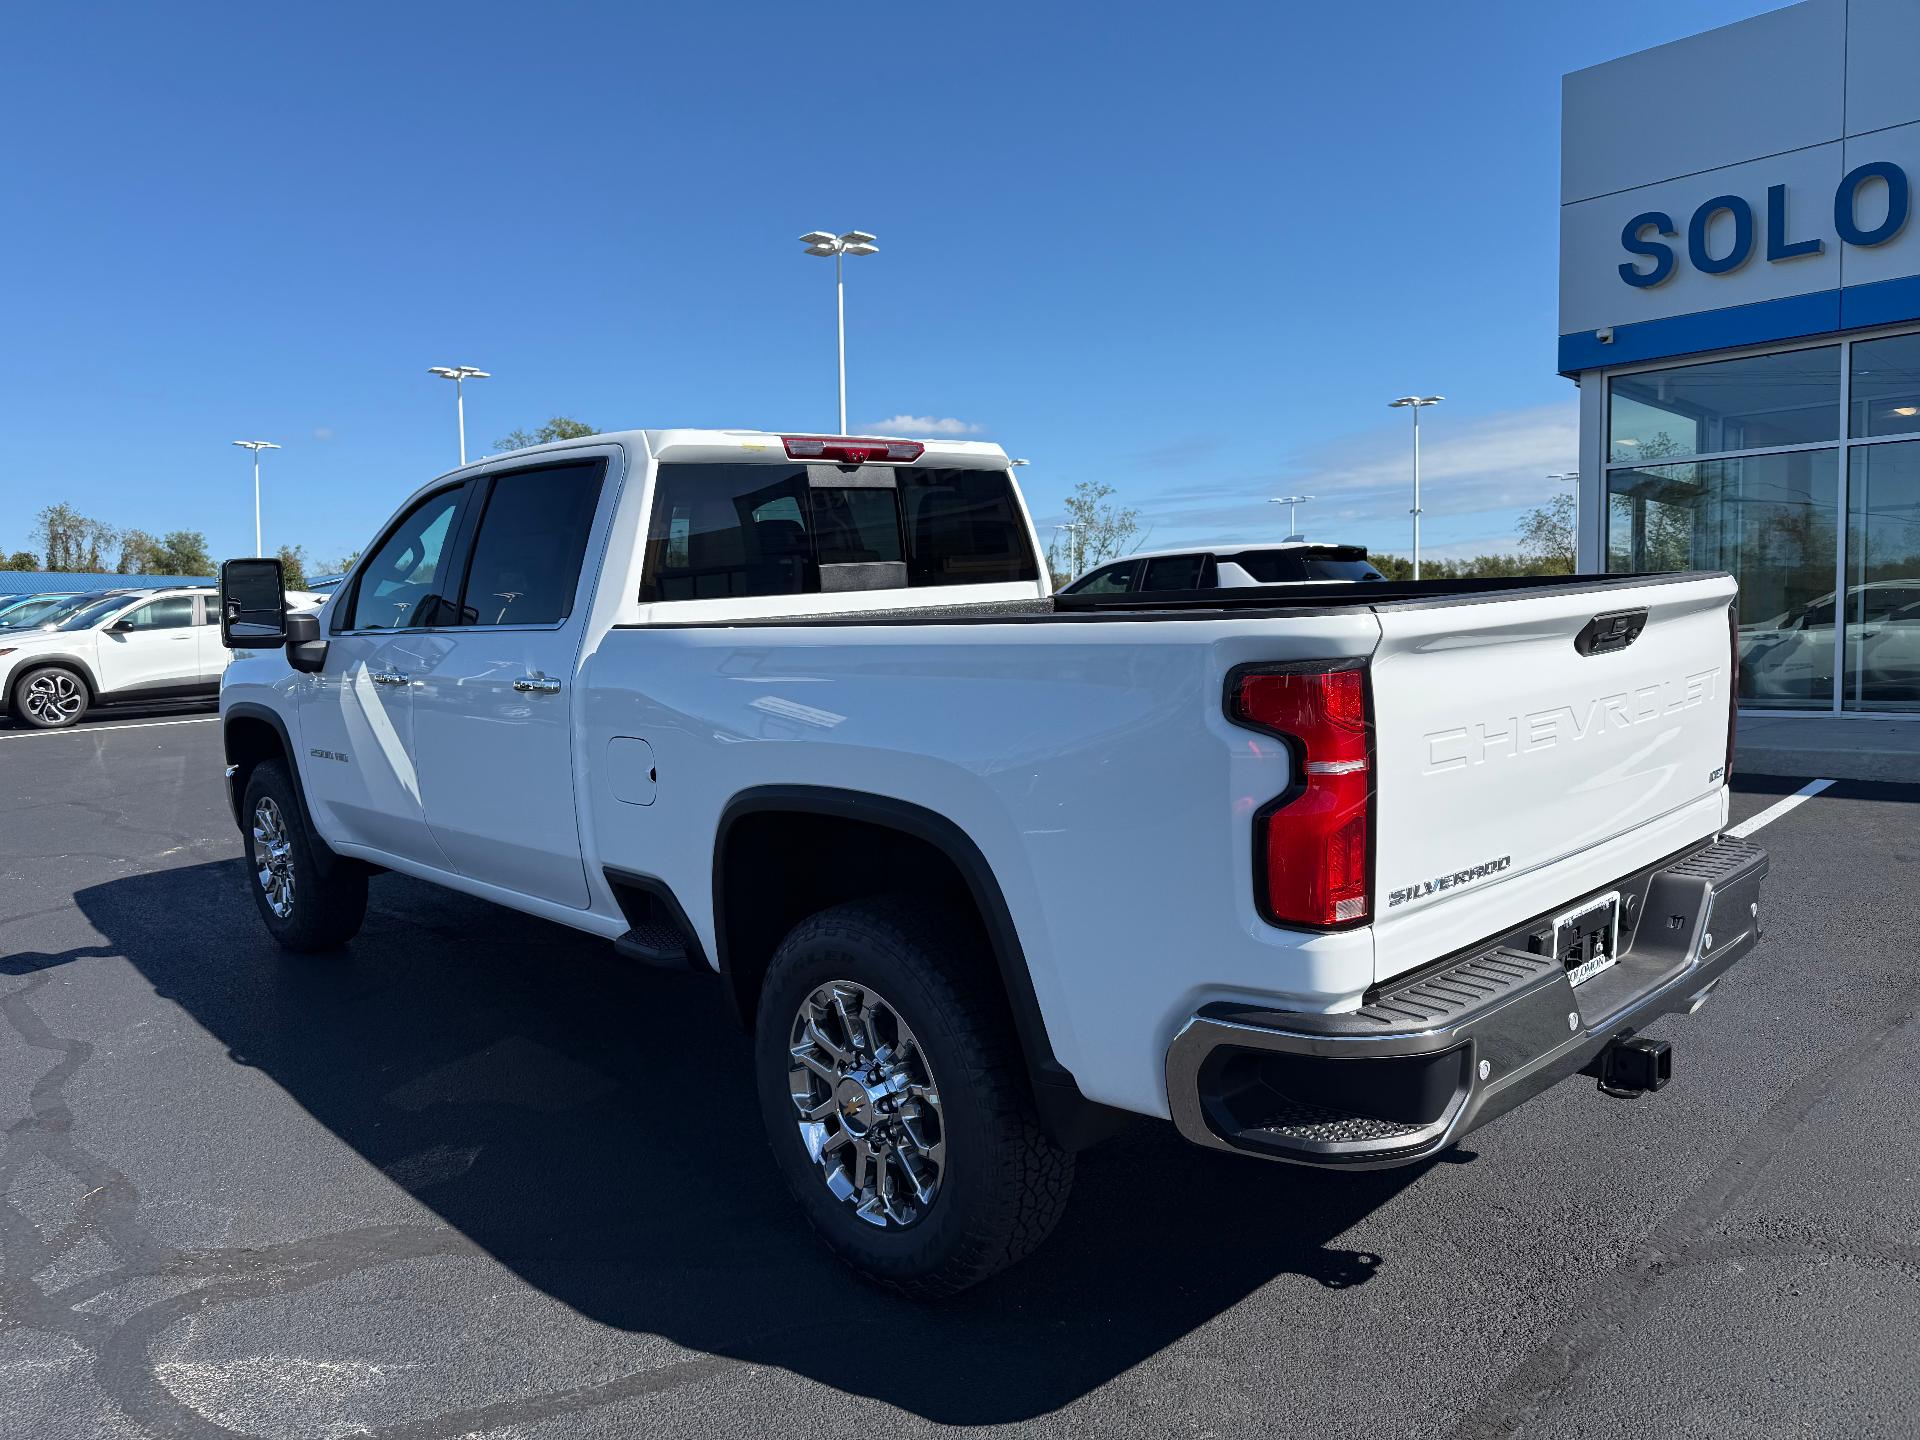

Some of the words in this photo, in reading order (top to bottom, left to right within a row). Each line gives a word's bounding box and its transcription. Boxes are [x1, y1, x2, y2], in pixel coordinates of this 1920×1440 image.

[1618, 161, 1911, 289] SOLO
[1421, 666, 1721, 777] CHEVROLET
[1388, 855, 1511, 907] SILVERADO
